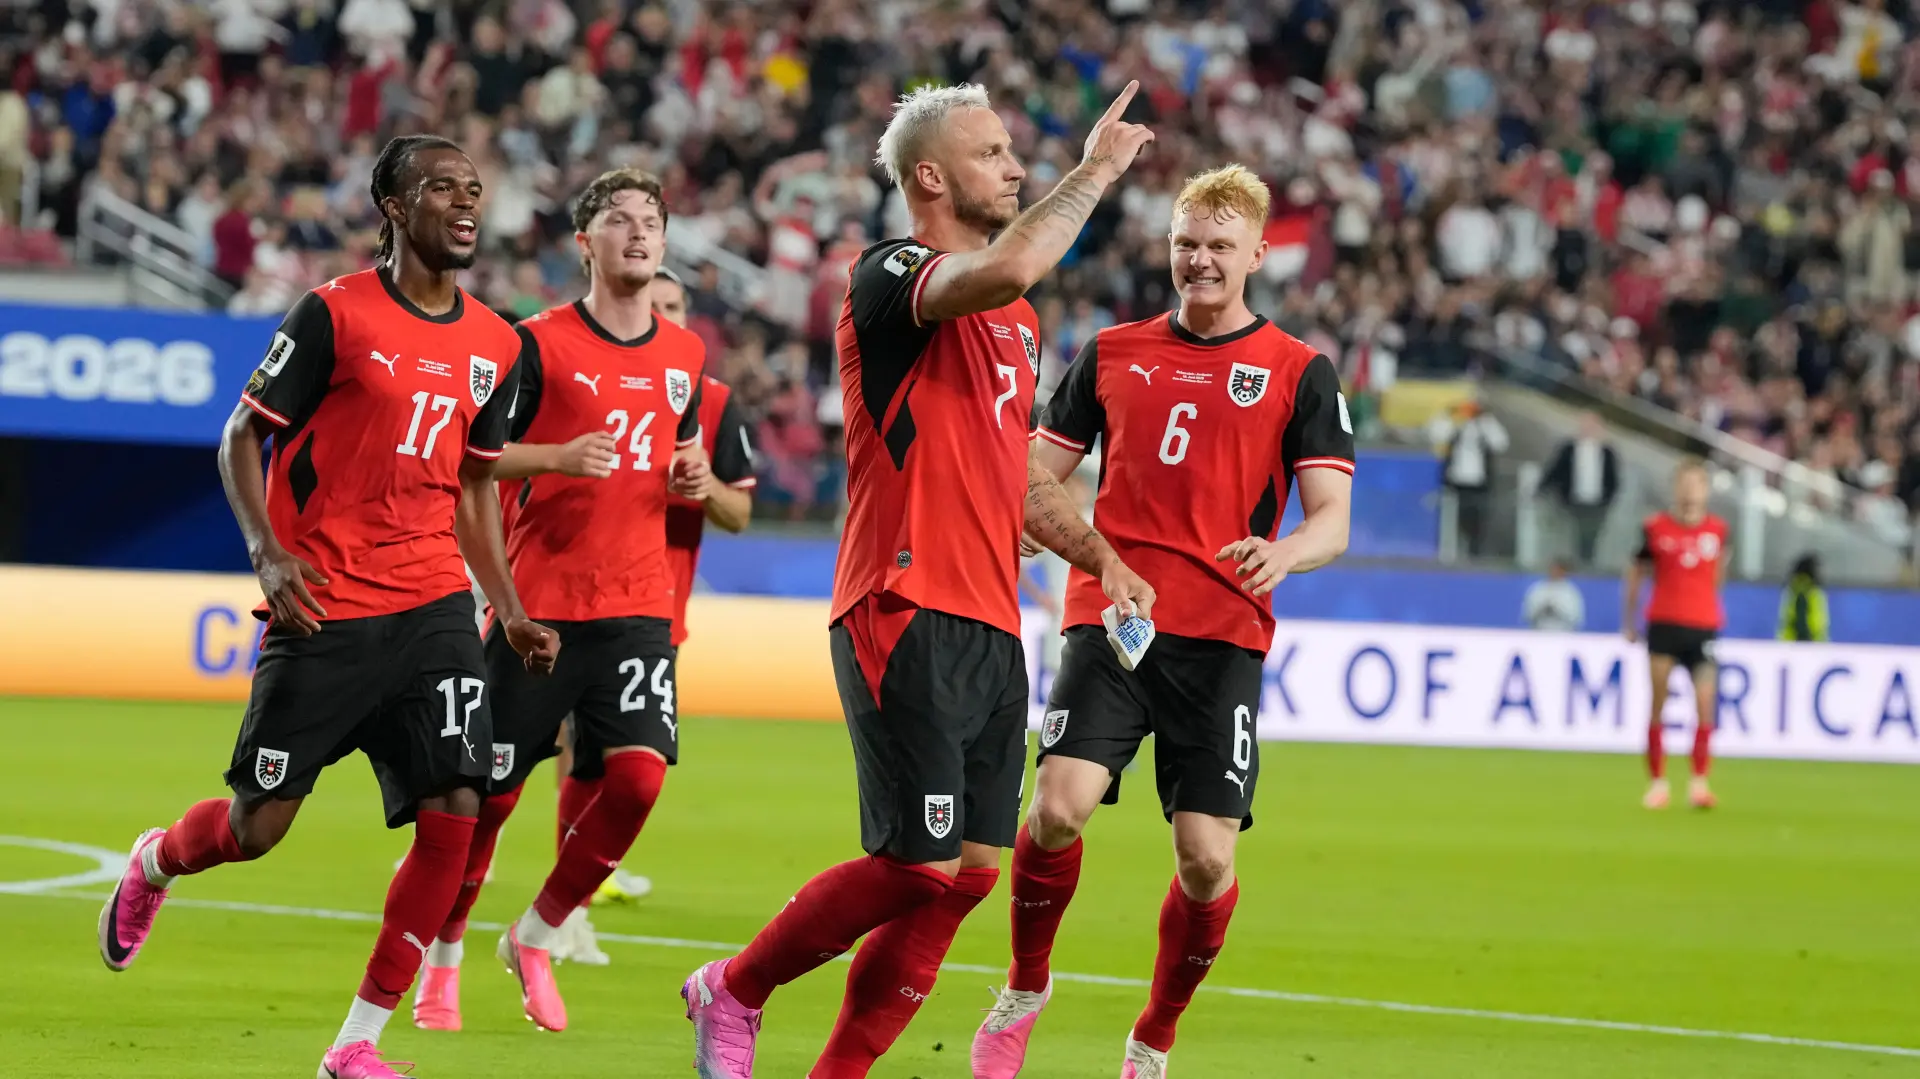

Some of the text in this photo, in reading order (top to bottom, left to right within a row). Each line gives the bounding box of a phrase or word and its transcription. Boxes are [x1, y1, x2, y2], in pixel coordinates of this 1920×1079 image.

[0, 331, 214, 406] 2026
[995, 363, 1018, 430] 7
[396, 391, 459, 460] 17
[605, 409, 656, 471] 24
[1158, 402, 1198, 465] 6
[1114, 625, 1135, 654] FOOTBALL
[1120, 617, 1143, 649] UNITES
[436, 677, 486, 738] 17
[618, 657, 673, 715] 24
[1345, 646, 1456, 720] OF
[1233, 704, 1251, 771] 6
